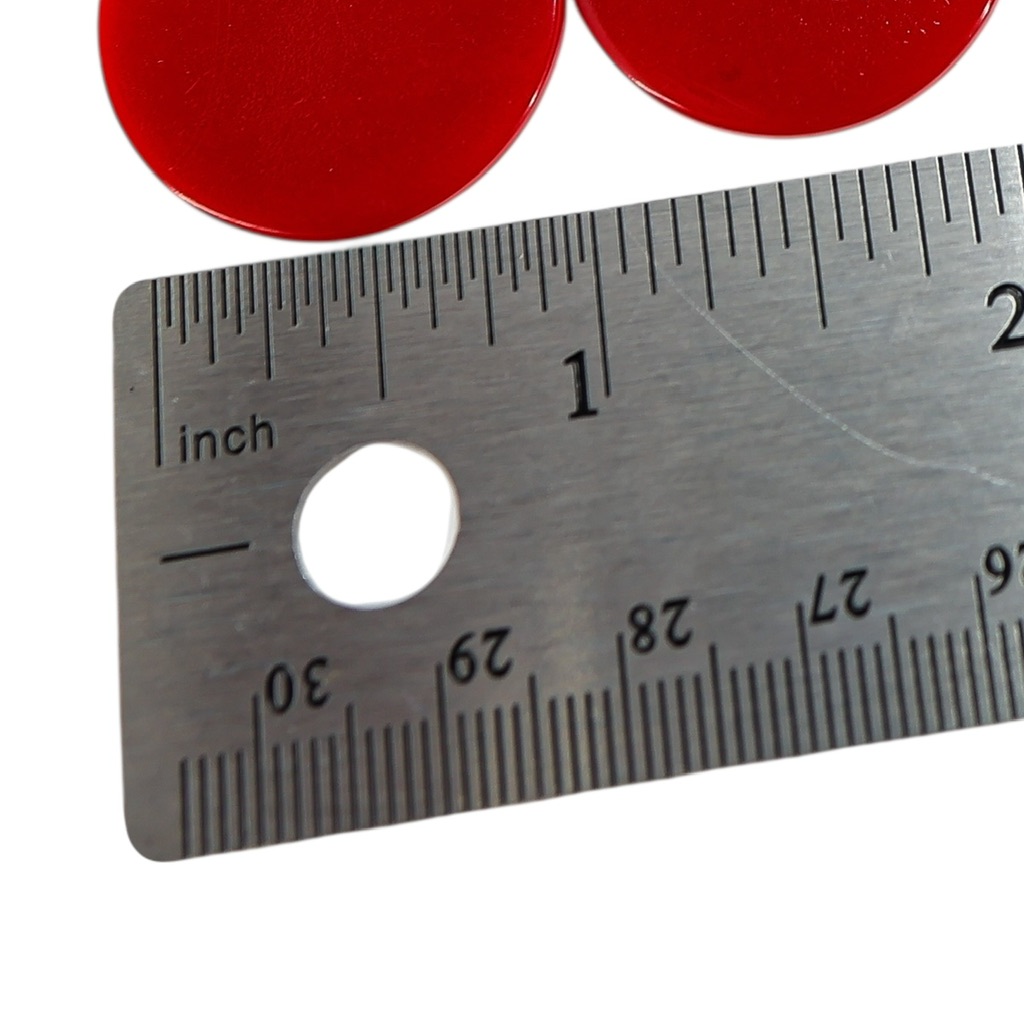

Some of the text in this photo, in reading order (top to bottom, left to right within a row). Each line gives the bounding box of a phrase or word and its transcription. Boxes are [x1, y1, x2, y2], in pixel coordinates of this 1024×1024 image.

[563, 350, 599, 419] 1
[178, 414, 275, 464] inch
[809, 569, 871, 624] 27
[627, 598, 693, 653] 28
[447, 627, 513, 684] 29
[265, 656, 331, 714] 30
